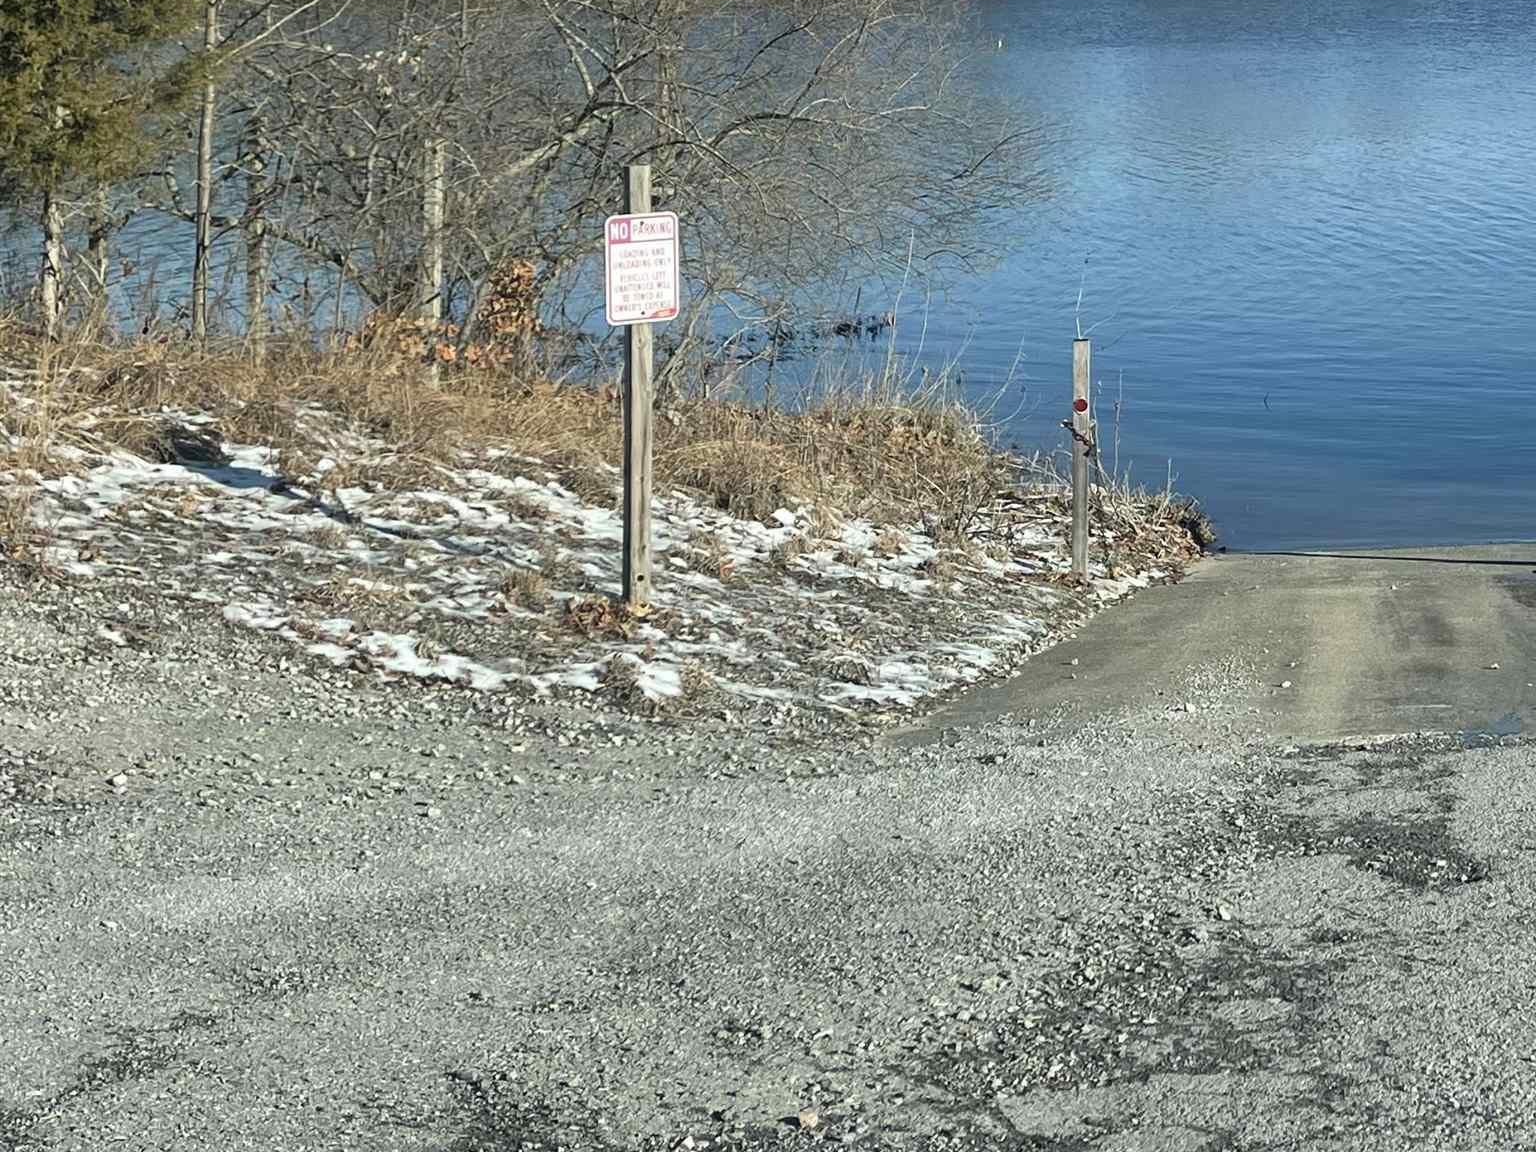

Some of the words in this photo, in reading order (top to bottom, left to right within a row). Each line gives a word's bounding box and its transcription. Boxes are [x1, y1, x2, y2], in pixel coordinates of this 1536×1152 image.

[610, 222, 628, 241] NO
[632, 221, 672, 234] PARKING
[619, 248, 648, 258] LOADING
[652, 247, 665, 256] AND
[613, 258, 652, 270] UNLOADING
[654, 257, 672, 268] ONLY
